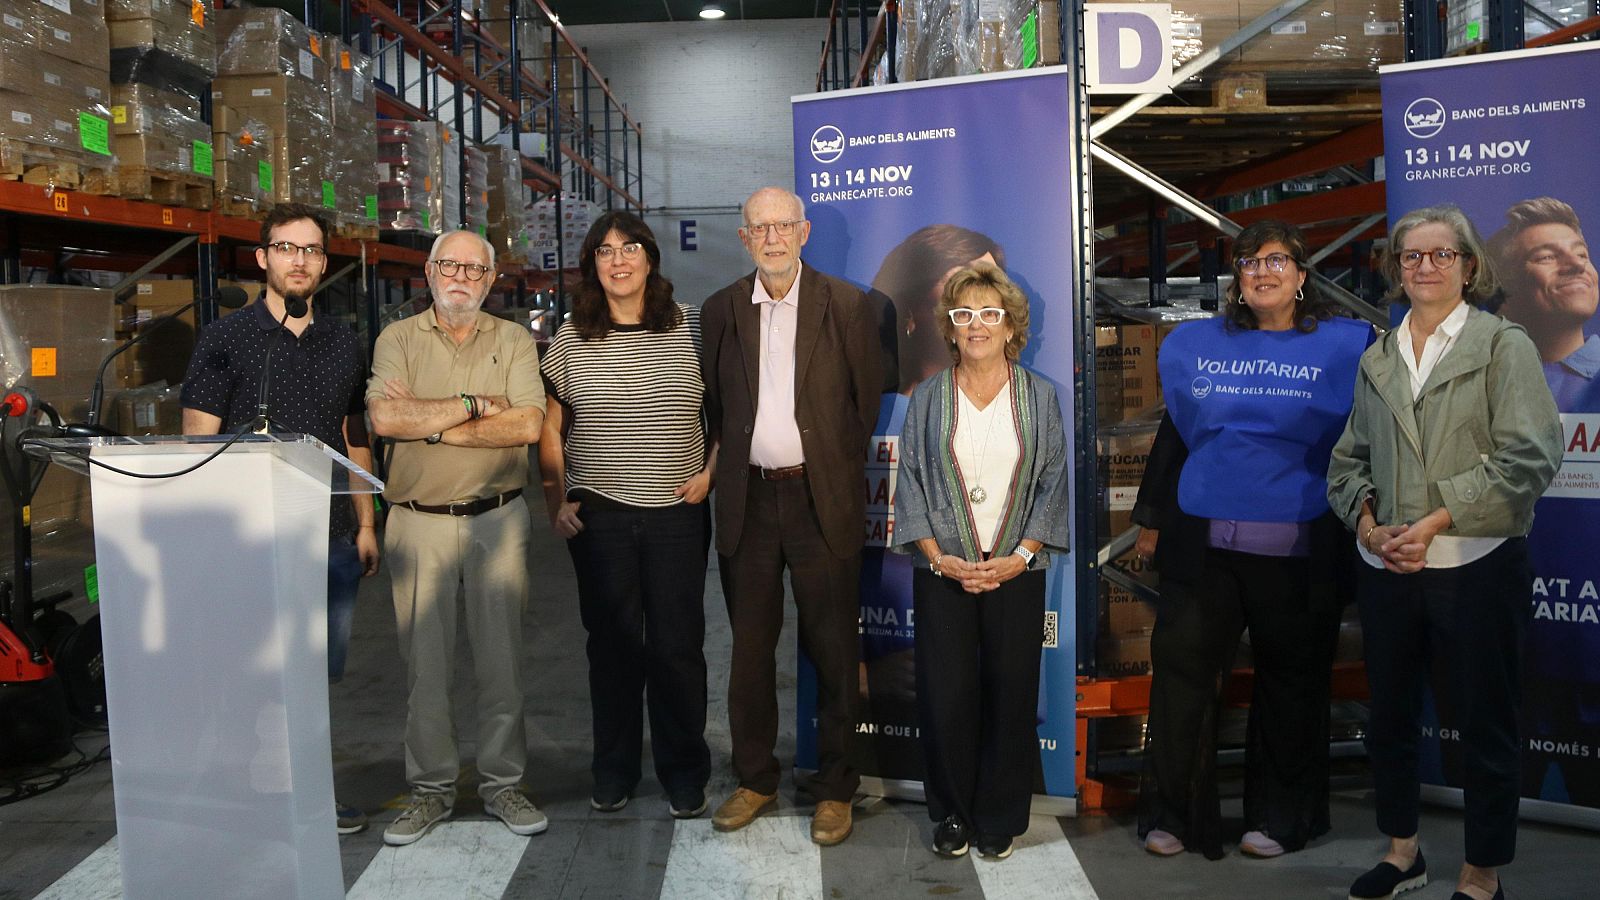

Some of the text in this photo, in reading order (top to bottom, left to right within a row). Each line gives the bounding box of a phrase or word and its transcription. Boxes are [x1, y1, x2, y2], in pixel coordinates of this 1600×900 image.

[1097, 11, 1163, 86] D
[1452, 98, 1586, 120] BANC DELS ALIMENTS
[850, 128, 956, 147] BANC DELS ALIMENTS
[1405, 148, 1429, 165] 13
[1448, 144, 1473, 162] 14
[1480, 140, 1531, 159] NOV
[811, 172, 830, 188] 13
[845, 168, 865, 185] 14
[871, 165, 912, 183] NOV
[1405, 162, 1531, 181] GRANRECAPTE.ORG
[811, 186, 913, 203] GRANRECAPTE.ORG
[680, 220, 697, 251] E
[543, 252, 557, 269] E
[1197, 357, 1321, 382] VOLUNTARIAT
[1215, 384, 1312, 399] BANC DELS ALIMENTS
[876, 441, 897, 463] EL
[1563, 481, 1600, 489] ALIMENTS
[1532, 600, 1600, 624] ARIA
[883, 725, 911, 737] QUE
[1039, 738, 1057, 751] TU
[1530, 738, 1590, 758] NOMÉS
